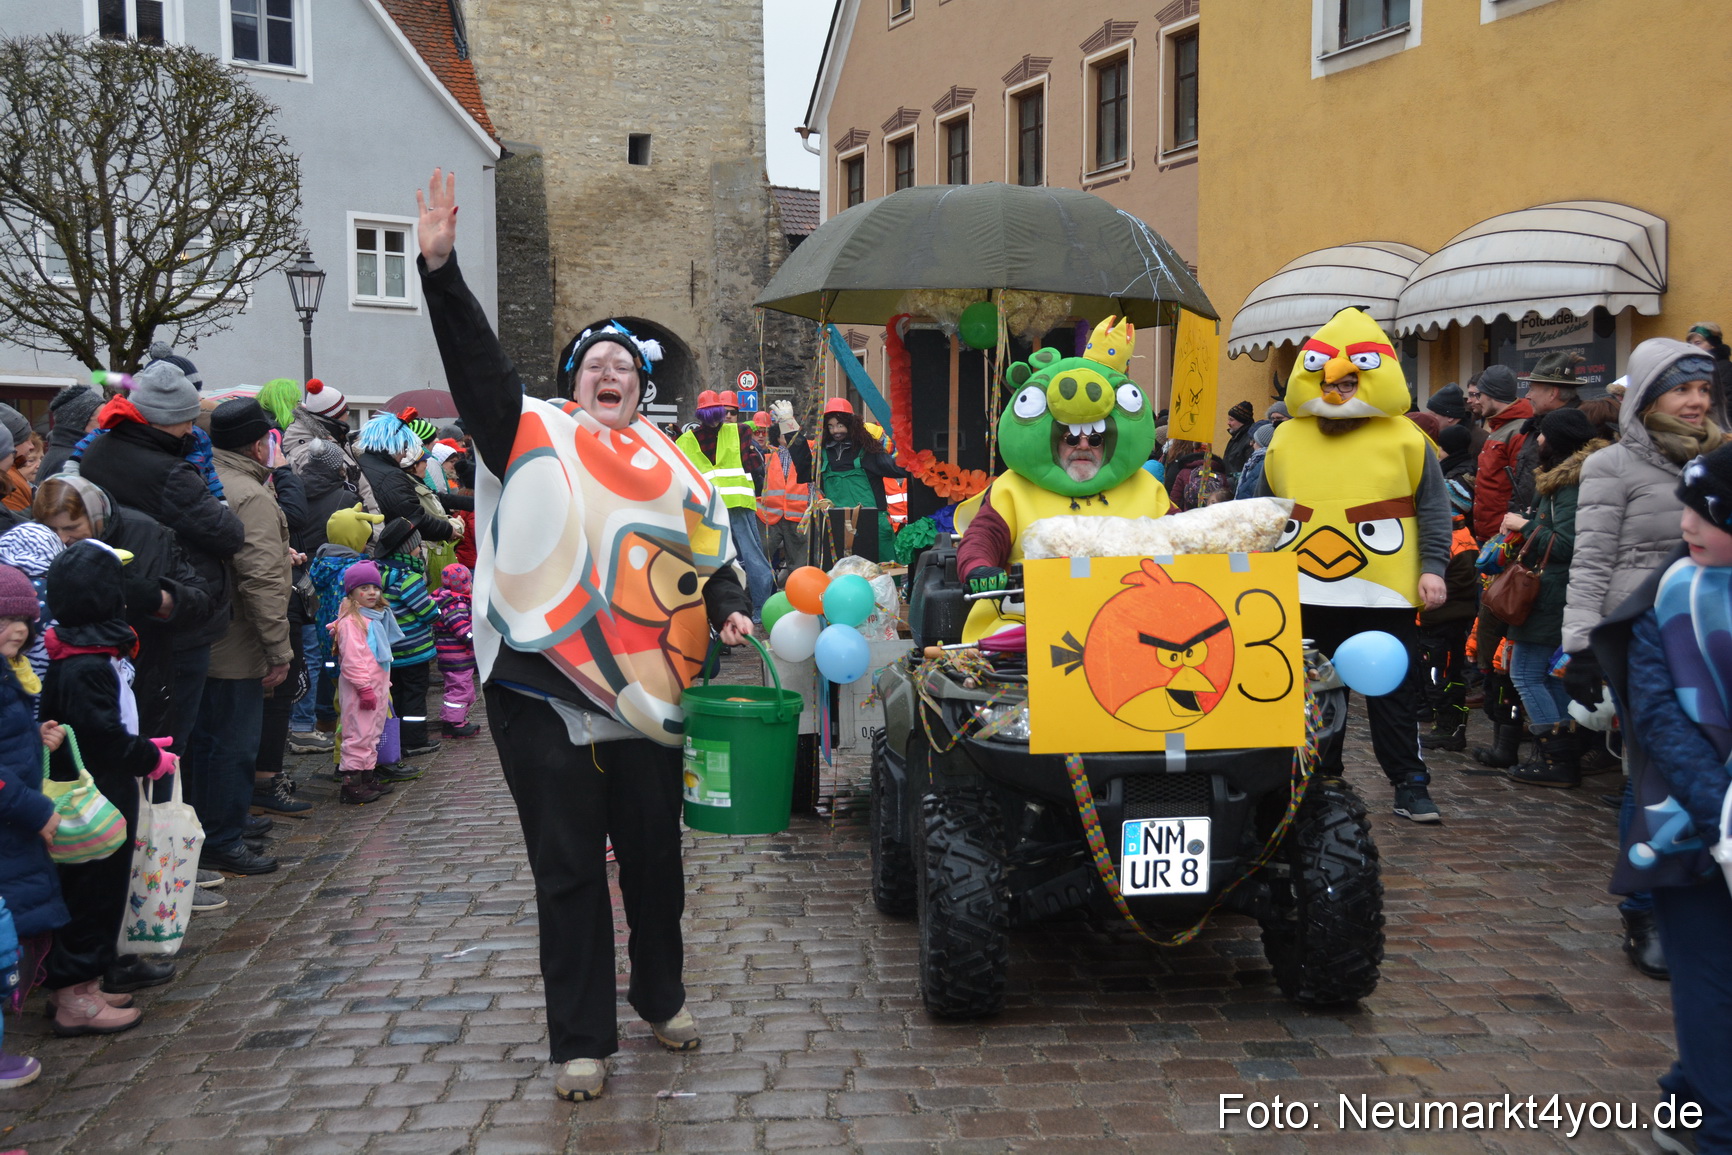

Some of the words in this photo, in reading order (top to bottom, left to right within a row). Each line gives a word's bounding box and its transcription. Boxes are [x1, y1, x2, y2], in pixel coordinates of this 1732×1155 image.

[1234, 588, 1294, 703] 3
[1128, 842, 1137, 852] D
[1143, 825, 1185, 855] NM
[1130, 859, 1171, 889] UR
[1180, 858, 1199, 886] 8
